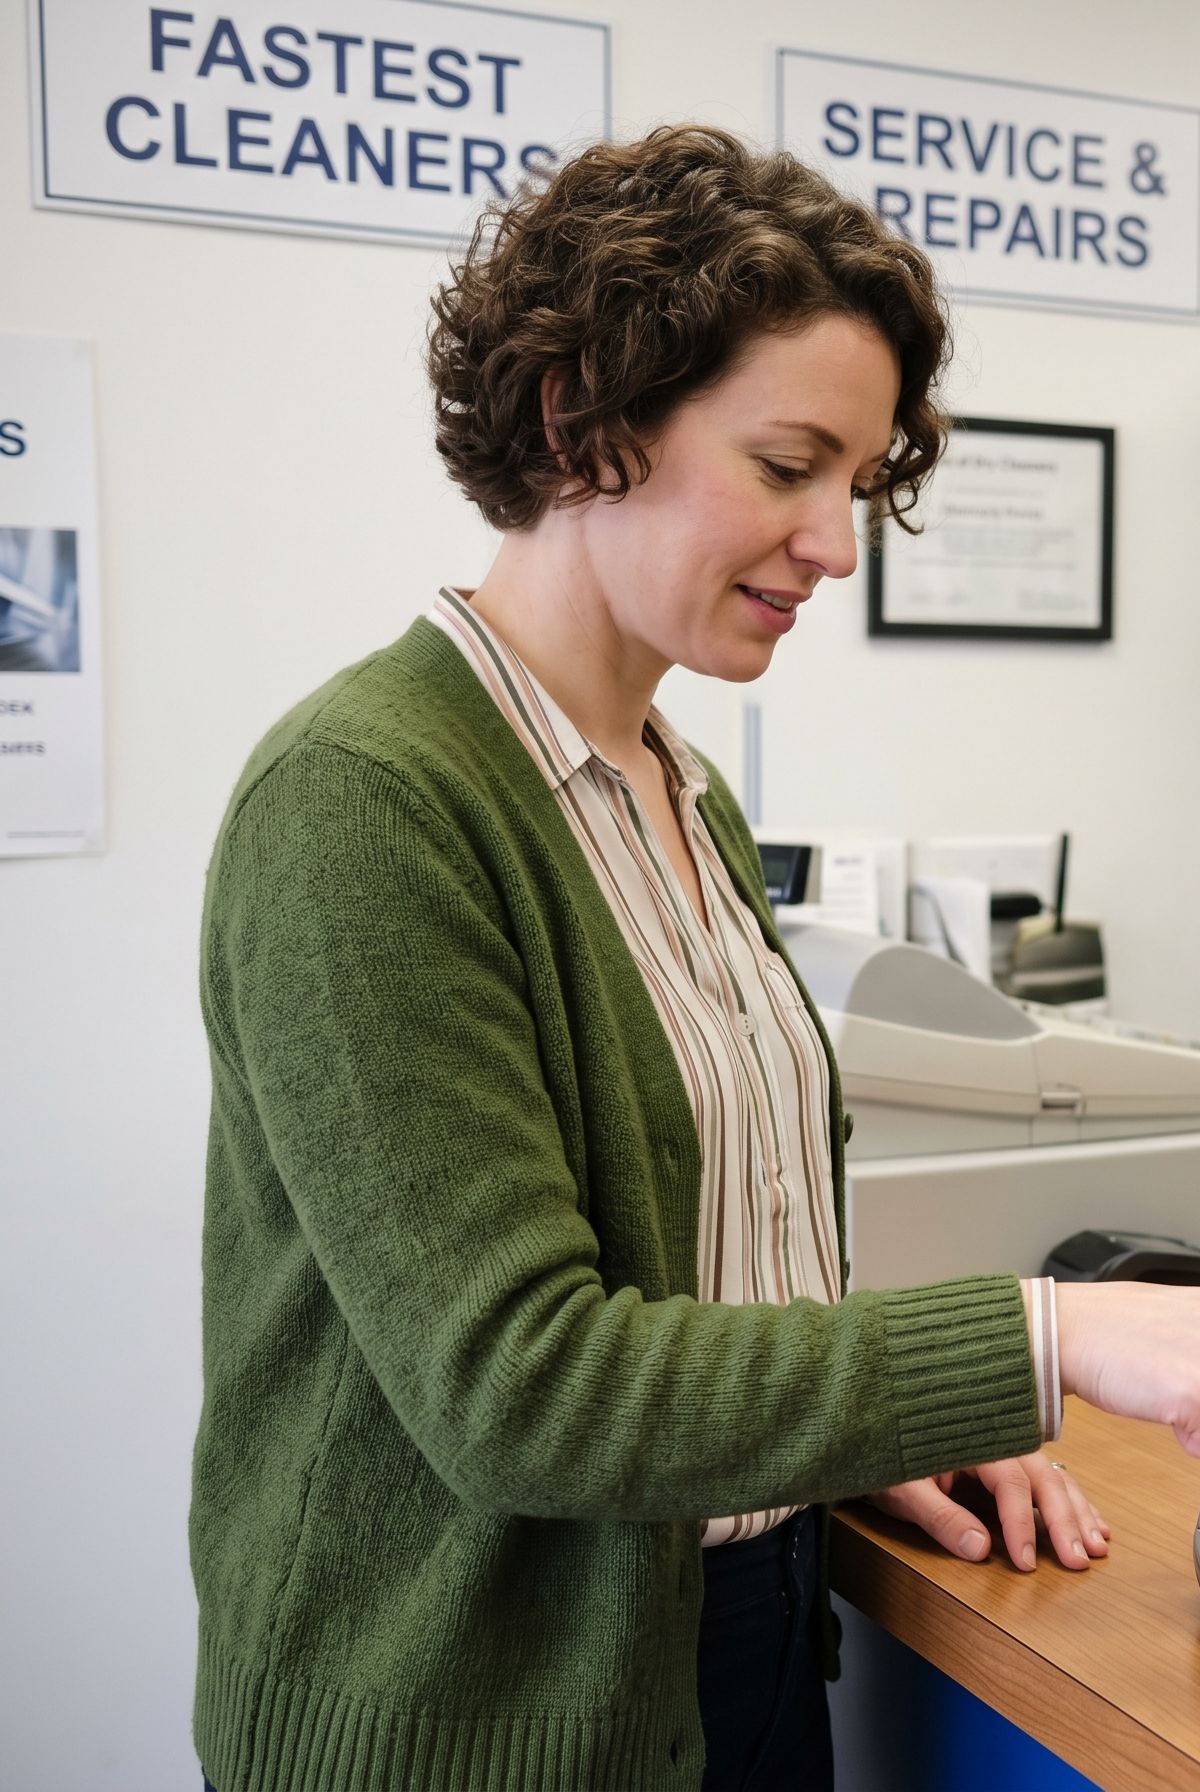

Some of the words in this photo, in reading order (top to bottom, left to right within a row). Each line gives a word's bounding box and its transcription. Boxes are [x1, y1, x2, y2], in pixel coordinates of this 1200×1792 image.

[149, 7, 522, 115] FASTEST
[823, 101, 1107, 188] SERVICE
[1129, 141, 1169, 197] &
[873, 186, 1150, 268] REPAIRS
